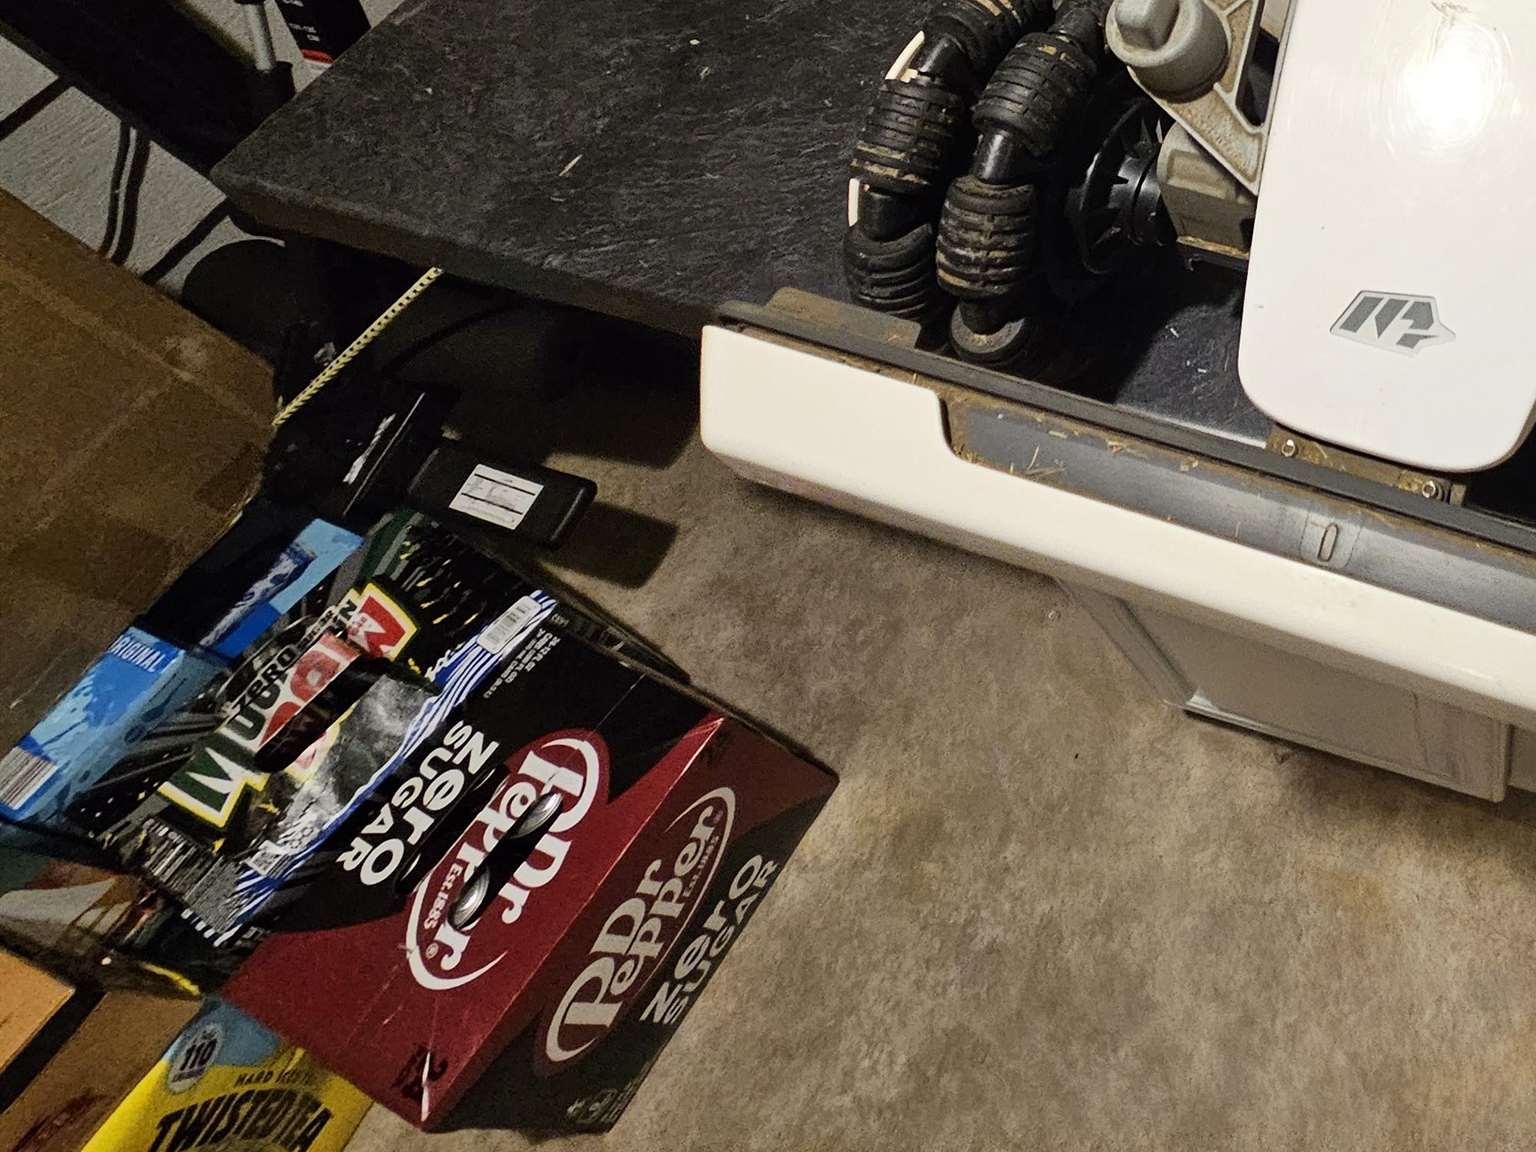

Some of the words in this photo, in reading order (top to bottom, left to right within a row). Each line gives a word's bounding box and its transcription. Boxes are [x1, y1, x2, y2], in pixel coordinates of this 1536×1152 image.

[336, 720, 473, 872] SUGAR
[498, 833, 572, 924] Dr
[546, 805, 717, 1062] Pepper
[590, 858, 663, 956] Dr
[663, 860, 778, 1025] SUGAR
[180, 1038, 218, 1071] 110
